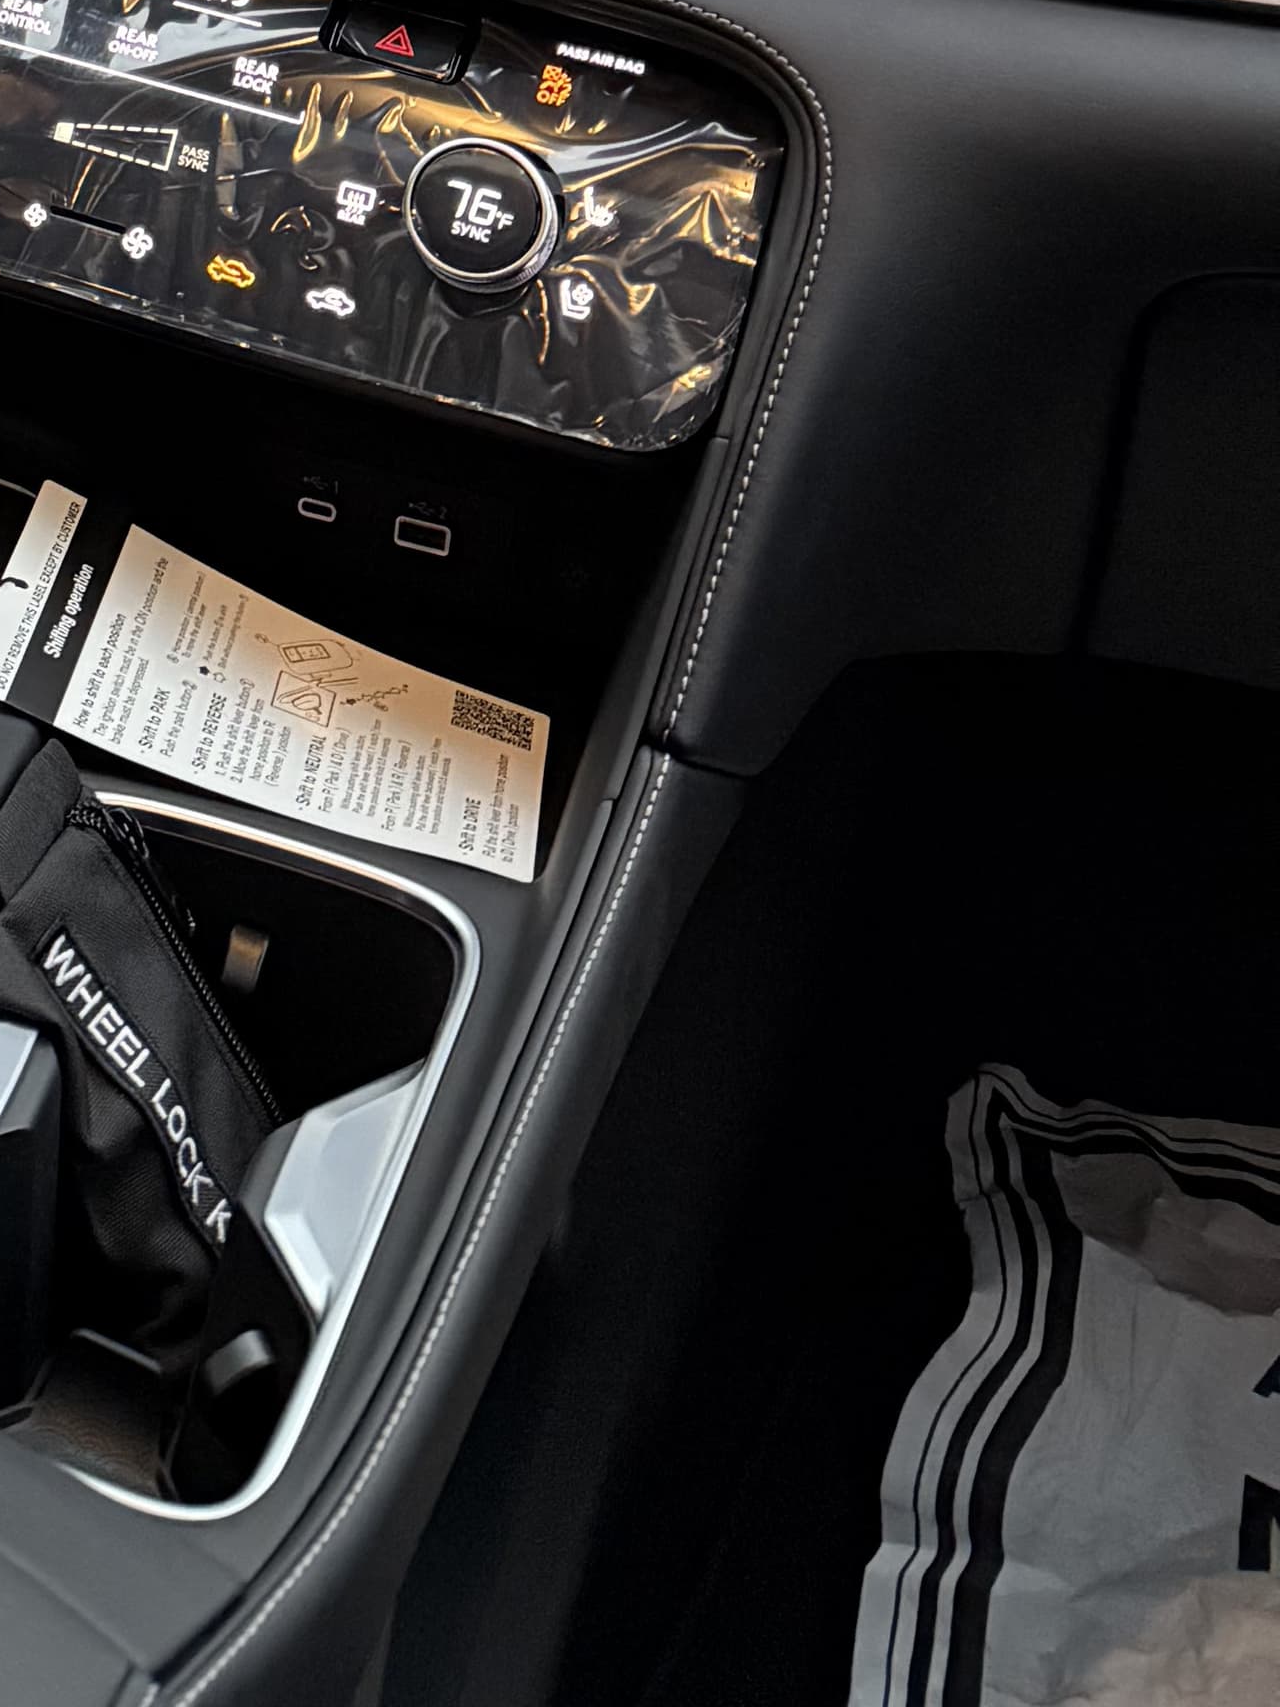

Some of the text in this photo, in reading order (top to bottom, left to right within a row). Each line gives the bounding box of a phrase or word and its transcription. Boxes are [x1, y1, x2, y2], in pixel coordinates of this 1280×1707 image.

[115, 26, 160, 49] REAR
[233, 57, 280, 82] REAR
[556, 42, 646, 75] PASS AIR BAG
[233, 71, 276, 96] LOCK
[177, 154, 210, 174] SYNC
[180, 143, 210, 161] PASS
[451, 218, 493, 244] SYNC
[54, 499, 82, 543] CUSTOMER
[50, 540, 64, 555] BY
[37, 550, 60, 585] EXCEPT
[27, 581, 48, 609] LABEL
[40, 559, 99, 662] Shifting operation
[20, 605, 38, 627] THIS
[6, 624, 30, 660] REMOVE
[0, 655, 17, 677] NOT
[71, 611, 129, 729] How to shift to each position
[136, 685, 171, 750] Shift to PARK
[190, 691, 228, 771] Shift to REVERSE
[295, 731, 327, 806] Shift to NEUTRAL
[457, 795, 481, 853] Shift to DRIVE
[41, 932, 157, 1088] WHEEL
[150, 1077, 214, 1206] LOCK
